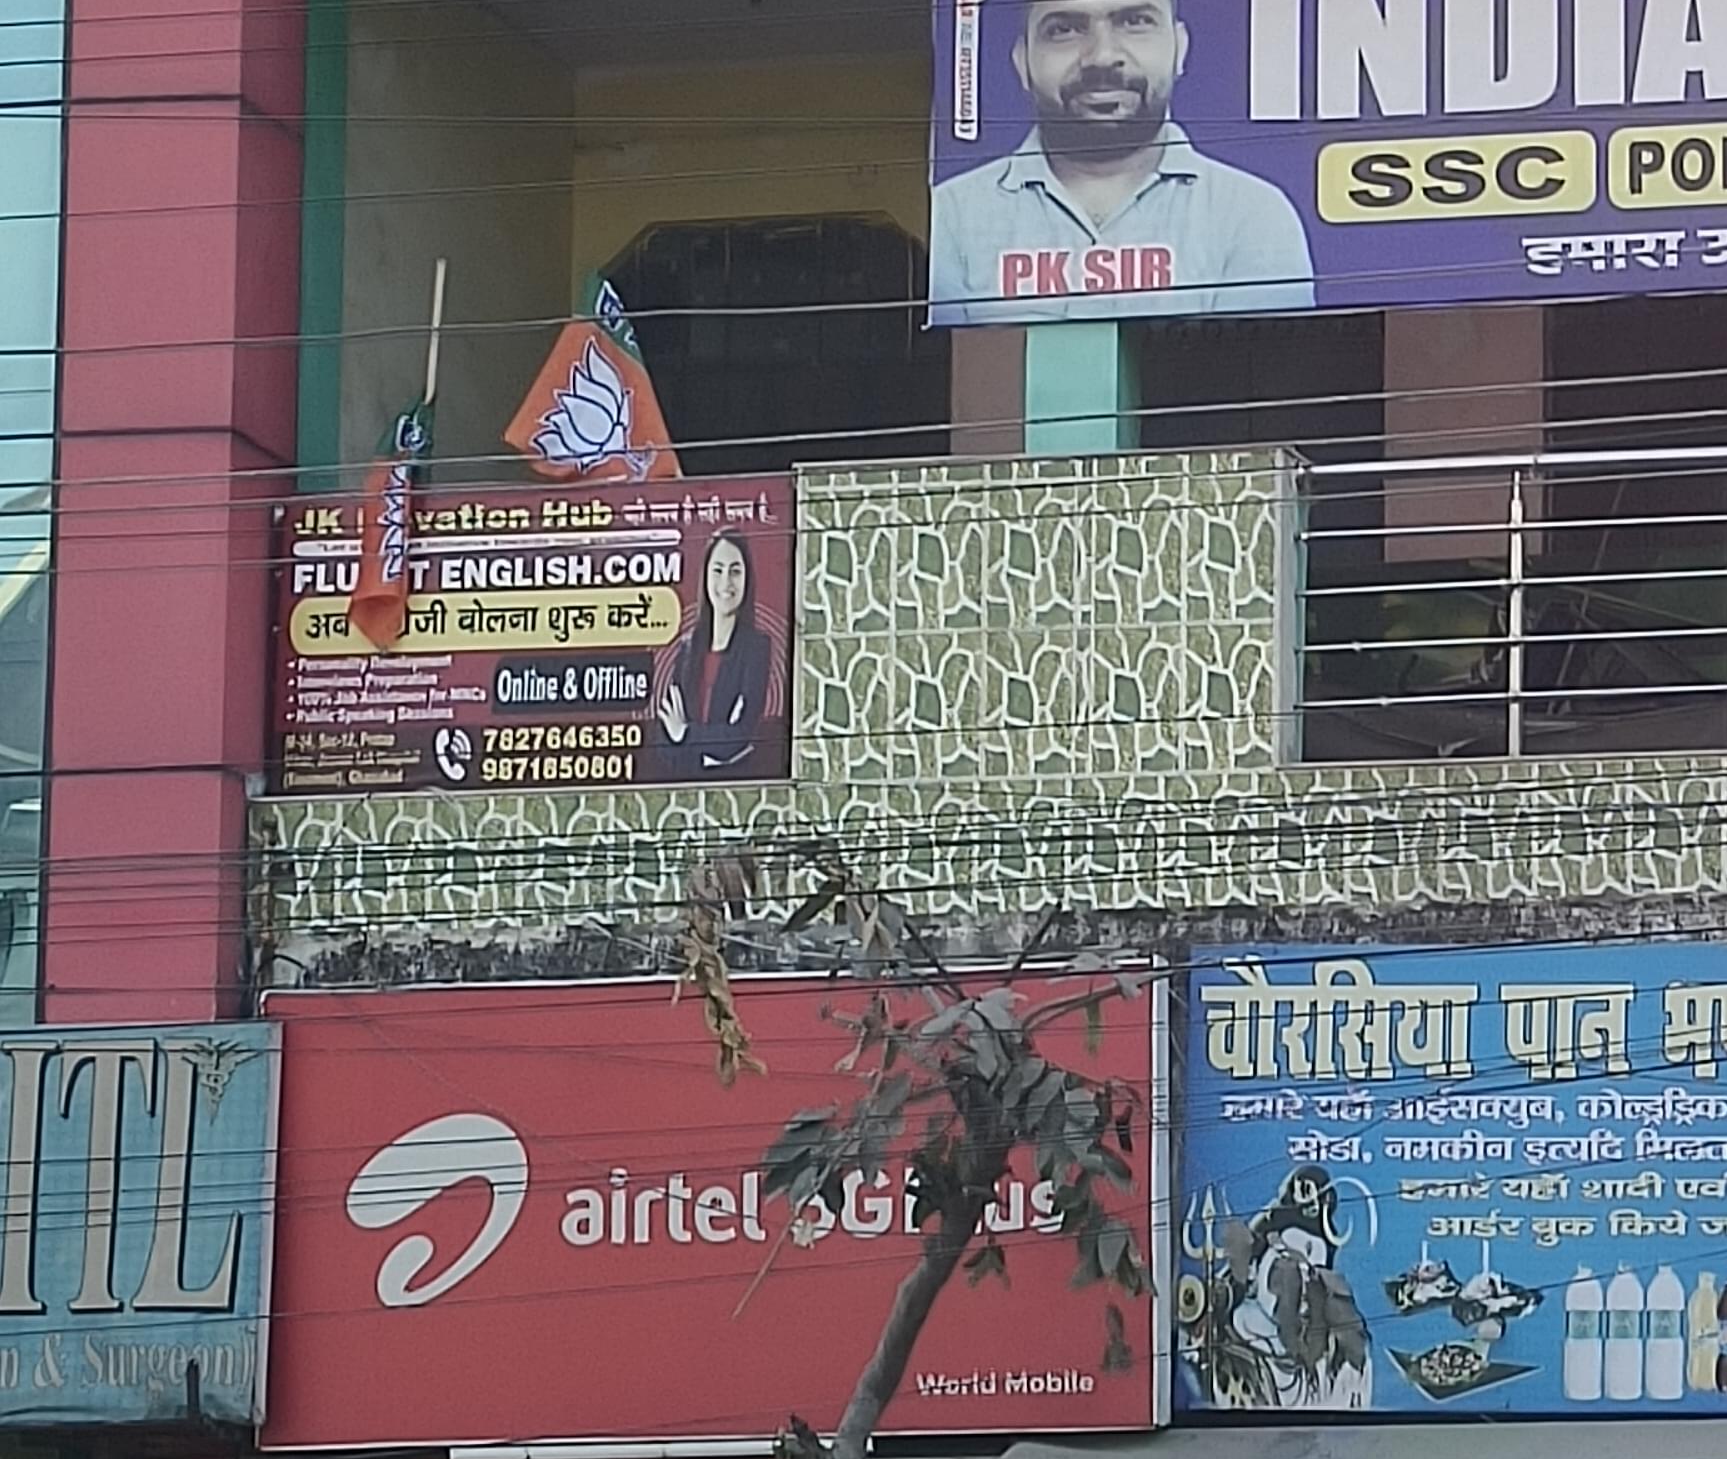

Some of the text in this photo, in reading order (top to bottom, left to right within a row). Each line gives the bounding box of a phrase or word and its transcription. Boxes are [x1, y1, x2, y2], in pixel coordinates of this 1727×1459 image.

[1345, 144, 1566, 212] SSC
[1001, 244, 1173, 296] PK SIR
[543, 499, 613, 527] Hub
[294, 552, 681, 593] FLUT ENGLISH.COM
[498, 668, 558, 703] Online
[563, 667, 577, 700] &
[584, 665, 648, 700] Offline
[1201, 957, 1478, 1081] चौरसिया
[1500, 982, 1634, 1081] पान
[1384, 1129, 1513, 1162] नमकीन
[561, 1168, 766, 1247] airtel
[33, 1335, 65, 1388] &
[81, 1340, 254, 1402] Surgeon)
[917, 1370, 1094, 1395] World Mobile
